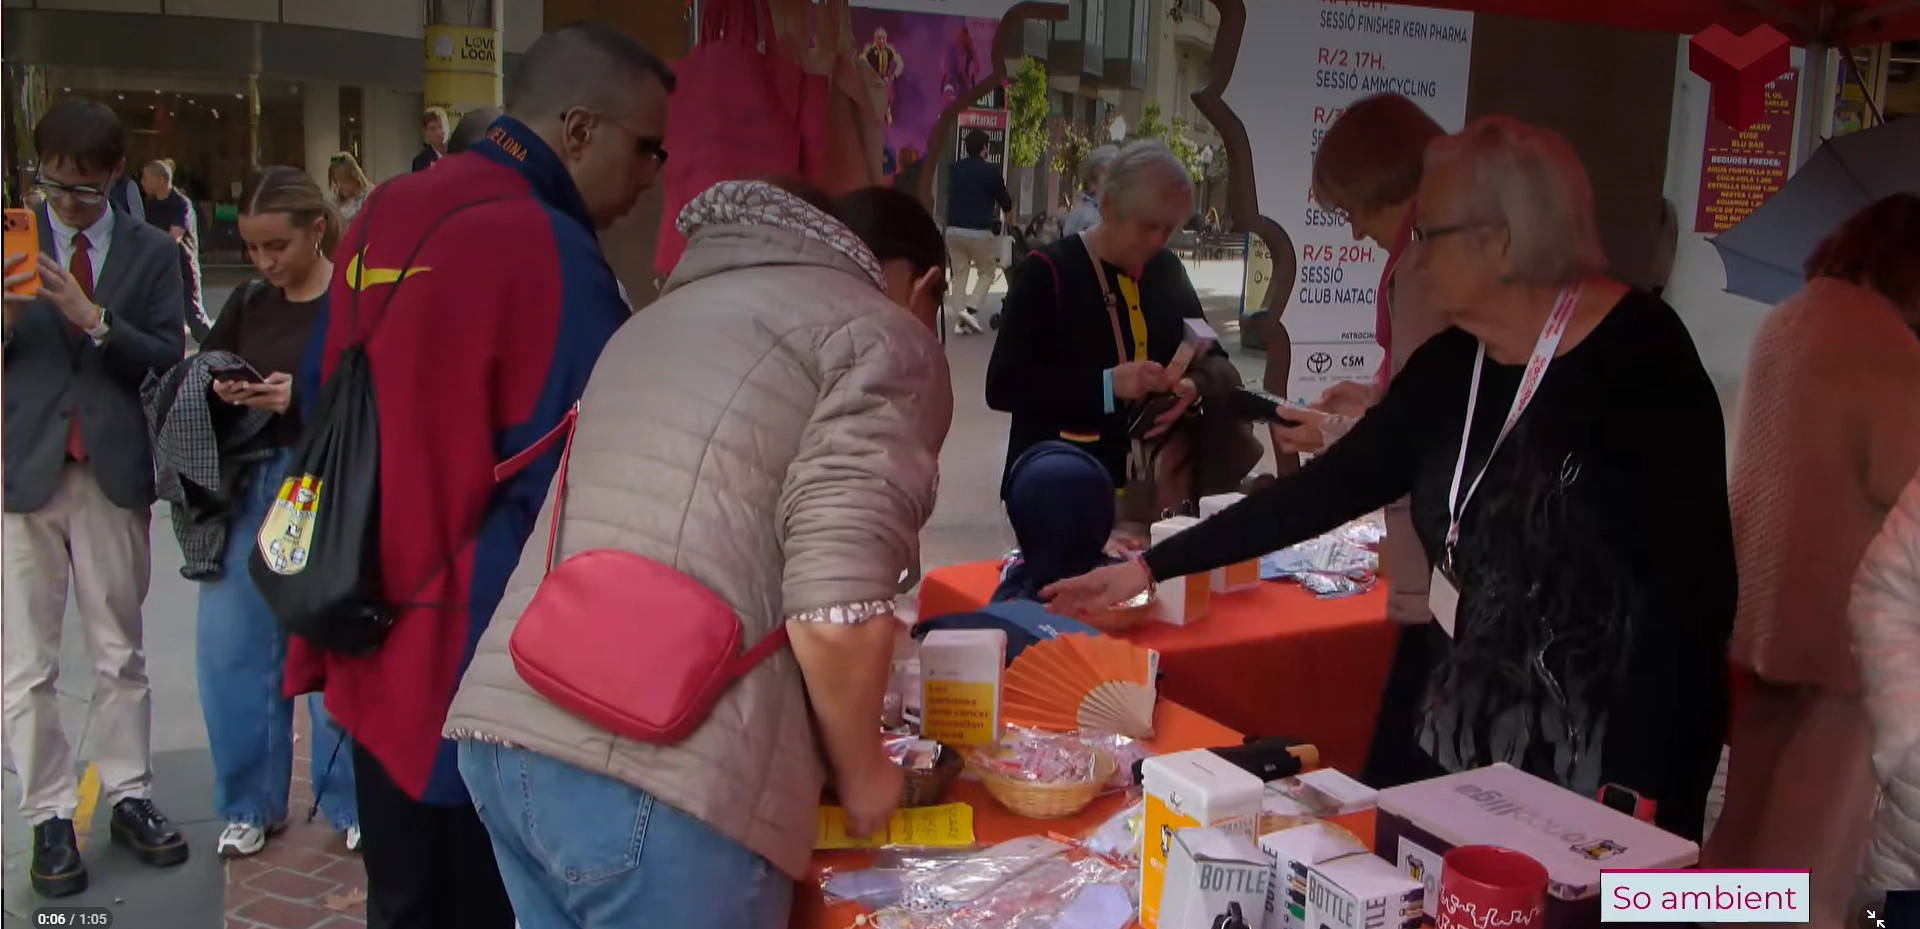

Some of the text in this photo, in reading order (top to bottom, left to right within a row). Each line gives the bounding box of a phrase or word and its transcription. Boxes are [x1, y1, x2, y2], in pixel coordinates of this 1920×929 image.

[1320, 9, 1468, 44] SESSIÓ FINISHER KERN PHARMA
[1318, 47, 1386, 71] R/2 17H.
[1316, 68, 1437, 98] SESSIÓ AMMCYCLING
[486, 126, 529, 163] ELONA
[1303, 244, 1376, 264] R/5 20H.
[1301, 263, 1344, 284] SESSIÓ
[1299, 287, 1332, 305] CLUB
[1341, 355, 1365, 368] CSM
[1199, 863, 1269, 896] BOTTLE
[1308, 874, 1355, 928] BOTTLE
